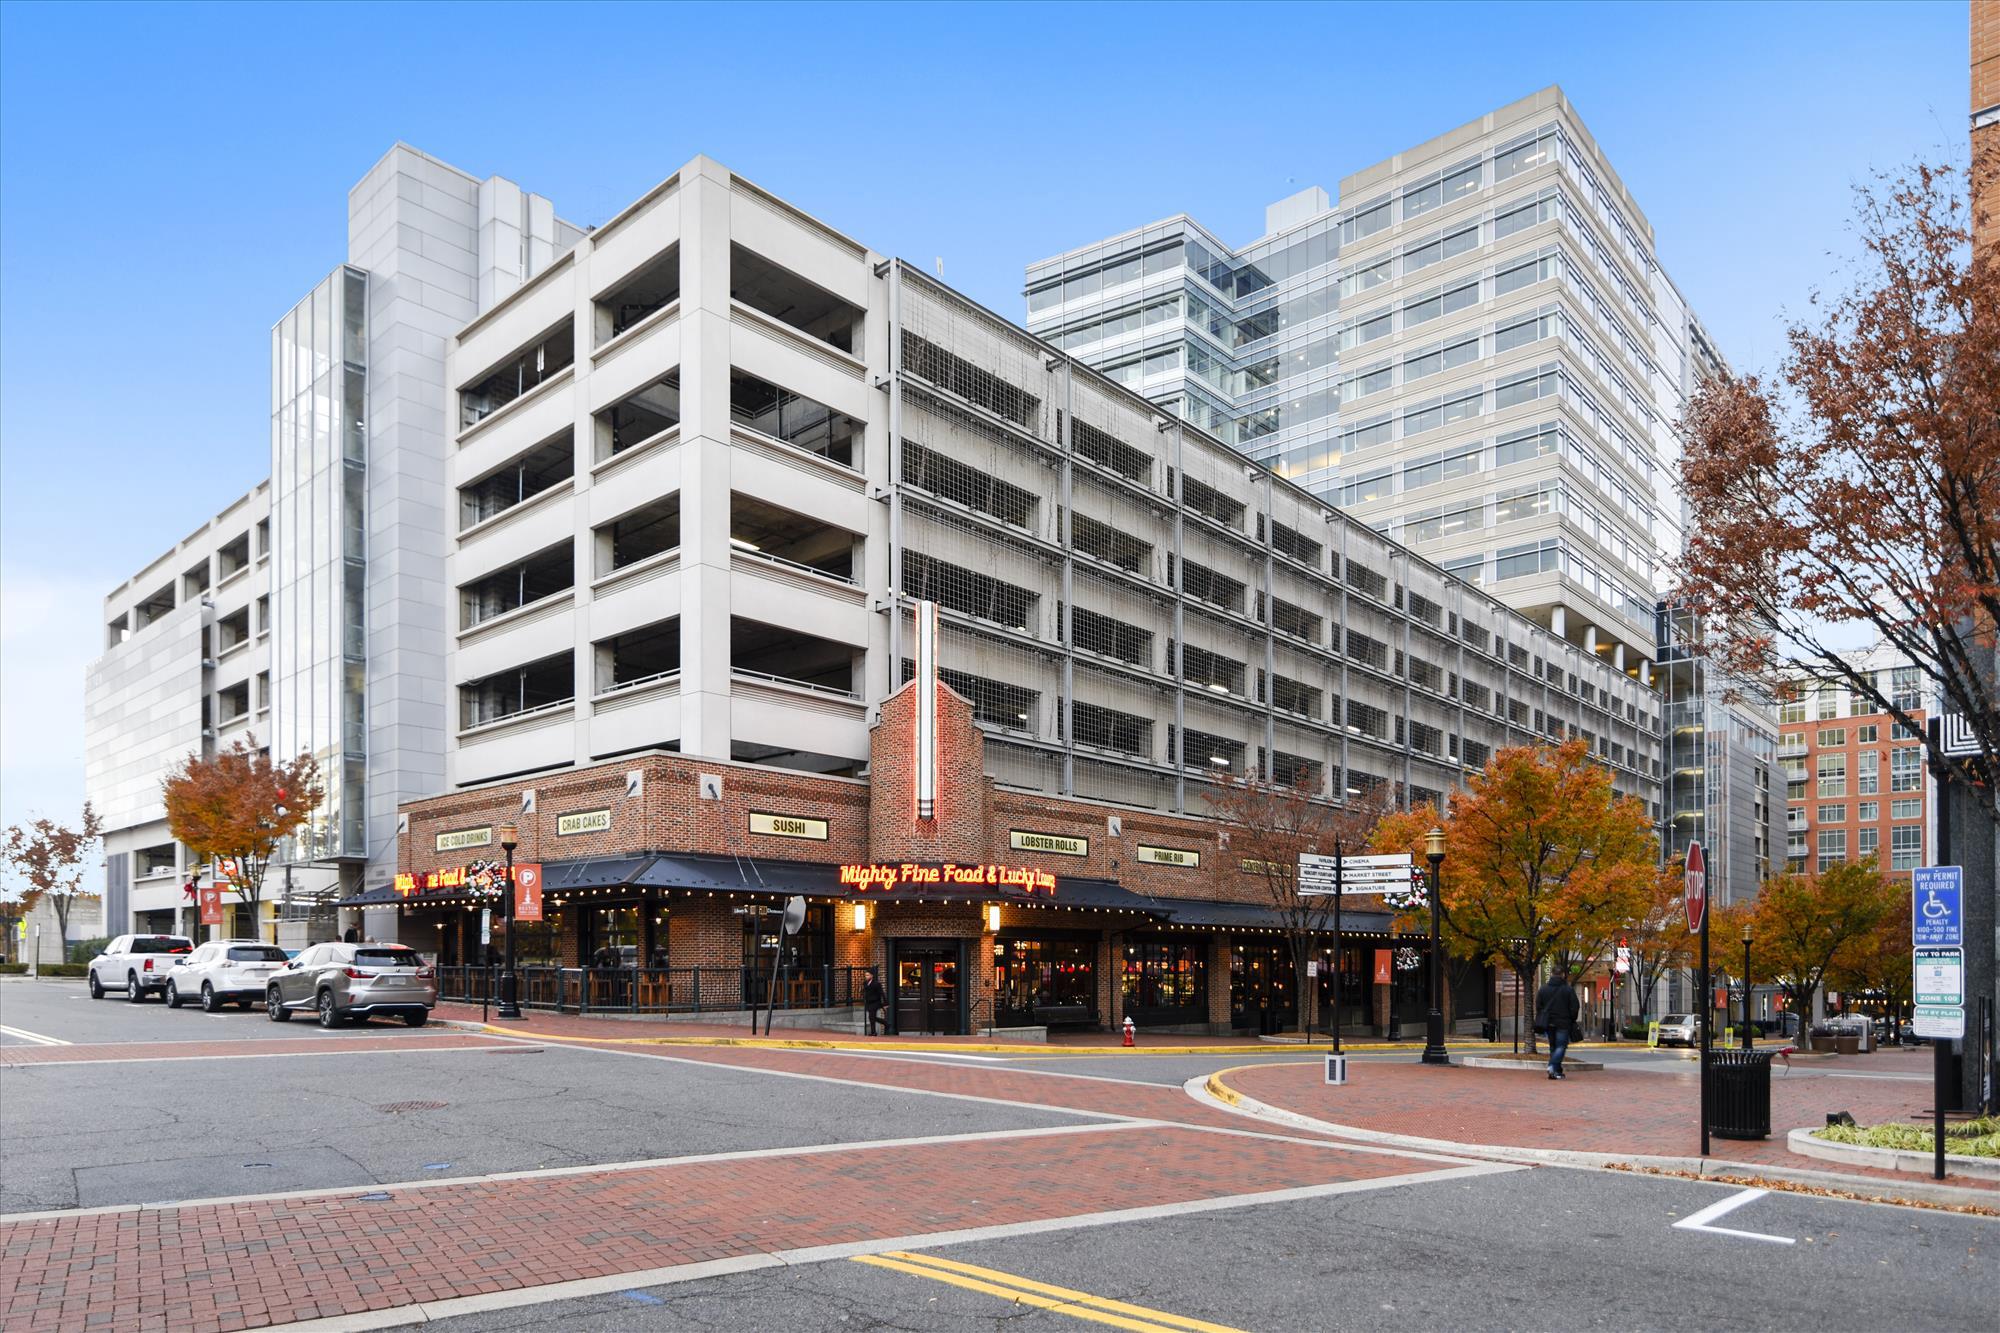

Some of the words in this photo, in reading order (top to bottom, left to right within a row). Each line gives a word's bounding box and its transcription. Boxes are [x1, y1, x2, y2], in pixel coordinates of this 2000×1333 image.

[562, 817, 581, 831] CRAB
[583, 814, 606, 828] CAKES
[773, 819, 806, 834] SUSHI
[440, 836, 450, 848] ICE
[450, 834, 466, 847] COLD
[466, 831, 488, 844] DRINKS
[1021, 835, 1054, 849] LOBSTER
[1055, 839, 1078, 852] ROLLS
[1154, 850, 1173, 862] PRIME
[1173, 853, 1184, 863] RIB
[840, 864, 898, 890] Mighty
[900, 864, 940, 883] Fine
[942, 864, 985, 883] Food
[986, 865, 997, 883] &
[999, 866, 1034, 893] Lucky
[1916, 873, 1931, 881] DMV
[1933, 871, 1958, 880] PERMIT
[1687, 870, 1704, 900] STOP
[1920, 881, 1955, 890] REQUIRED
[1925, 918, 1949, 926] PENALTY
[1915, 933, 1944, 941] TOW-AWAY
[1945, 933, 1960, 941] ZONE
